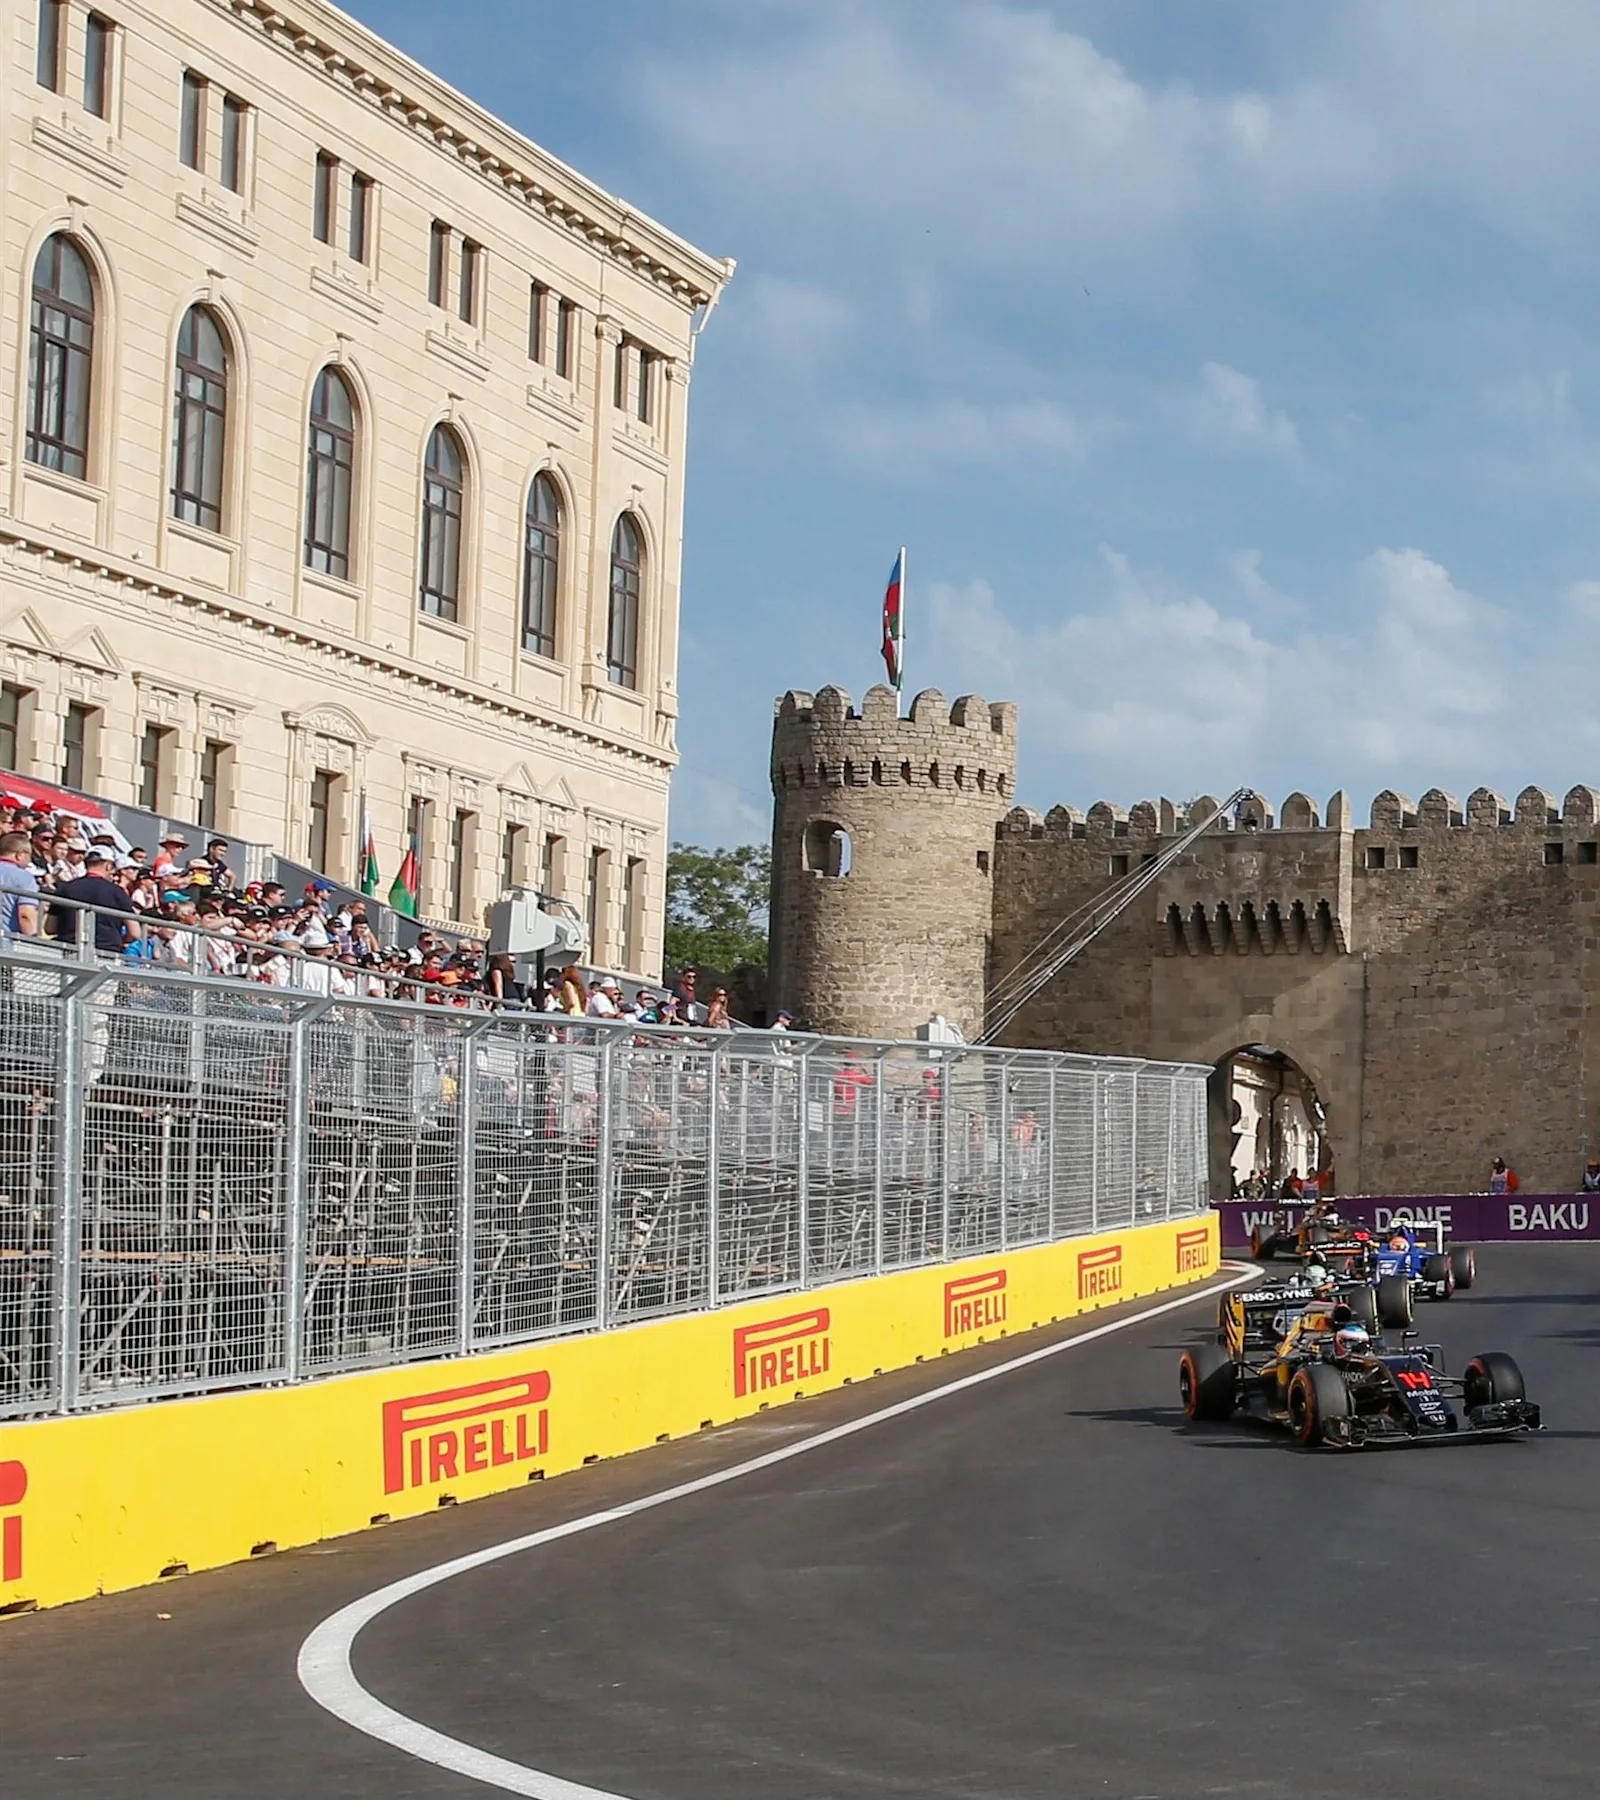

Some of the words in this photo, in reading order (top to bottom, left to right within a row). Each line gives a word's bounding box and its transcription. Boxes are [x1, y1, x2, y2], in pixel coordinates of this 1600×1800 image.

[1508, 1202, 1590, 1231] BAKU
[1077, 1245, 1122, 1300] PIRELLI
[1177, 1227, 1209, 1274] PIRELLI
[944, 1269, 1007, 1338] PIRELLI
[734, 1307, 830, 1399] PIRELLI
[1396, 1371, 1432, 1389] 14
[1406, 1389, 1440, 1398] Mobil
[382, 1370, 551, 1495] PIRELLI
